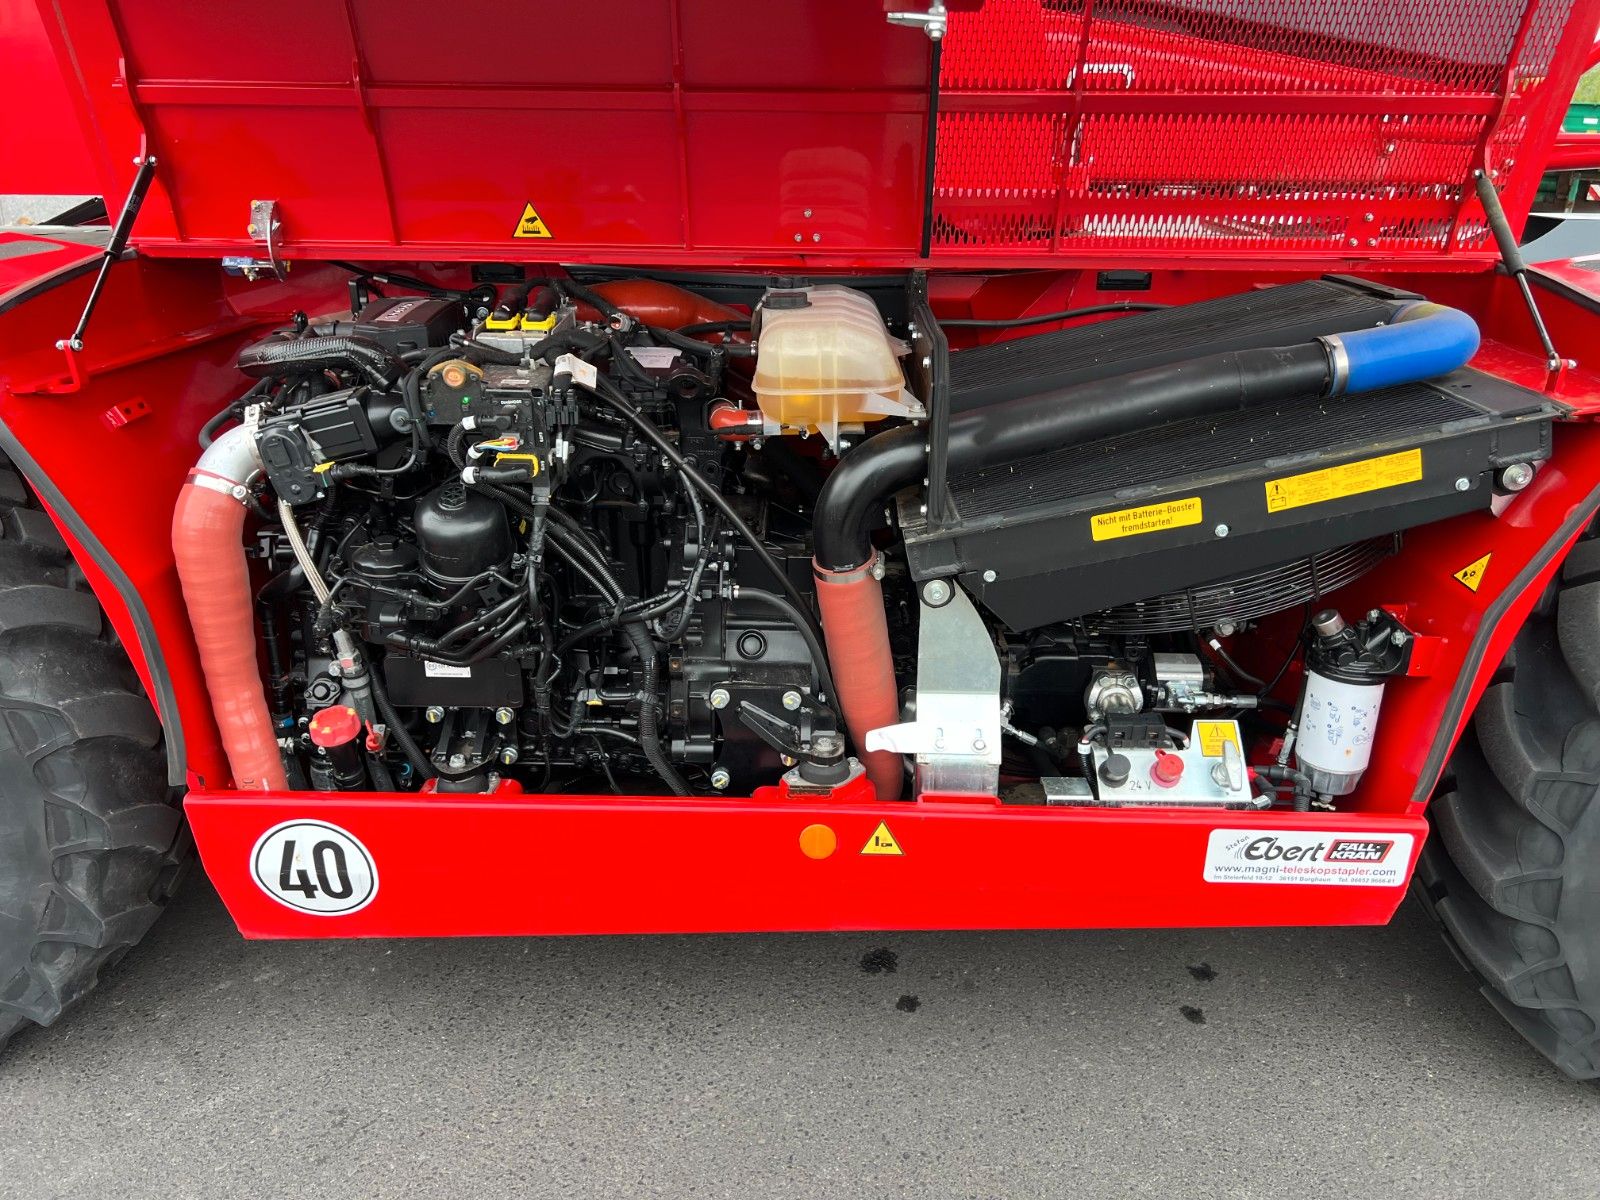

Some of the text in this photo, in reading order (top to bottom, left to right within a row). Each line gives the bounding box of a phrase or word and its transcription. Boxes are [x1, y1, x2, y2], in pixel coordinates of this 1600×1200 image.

[1097, 502, 1196, 526] Nicht mit Batterie-Booster
[1121, 516, 1174, 533] fremdstarten!
[1129, 780, 1151, 791] 24 V
[1225, 835, 1326, 862] Stefan Ebert
[1329, 850, 1382, 860] KRAN
[279, 840, 354, 900] 40
[1214, 865, 1397, 877] www.magni-teleskopstapler.com
